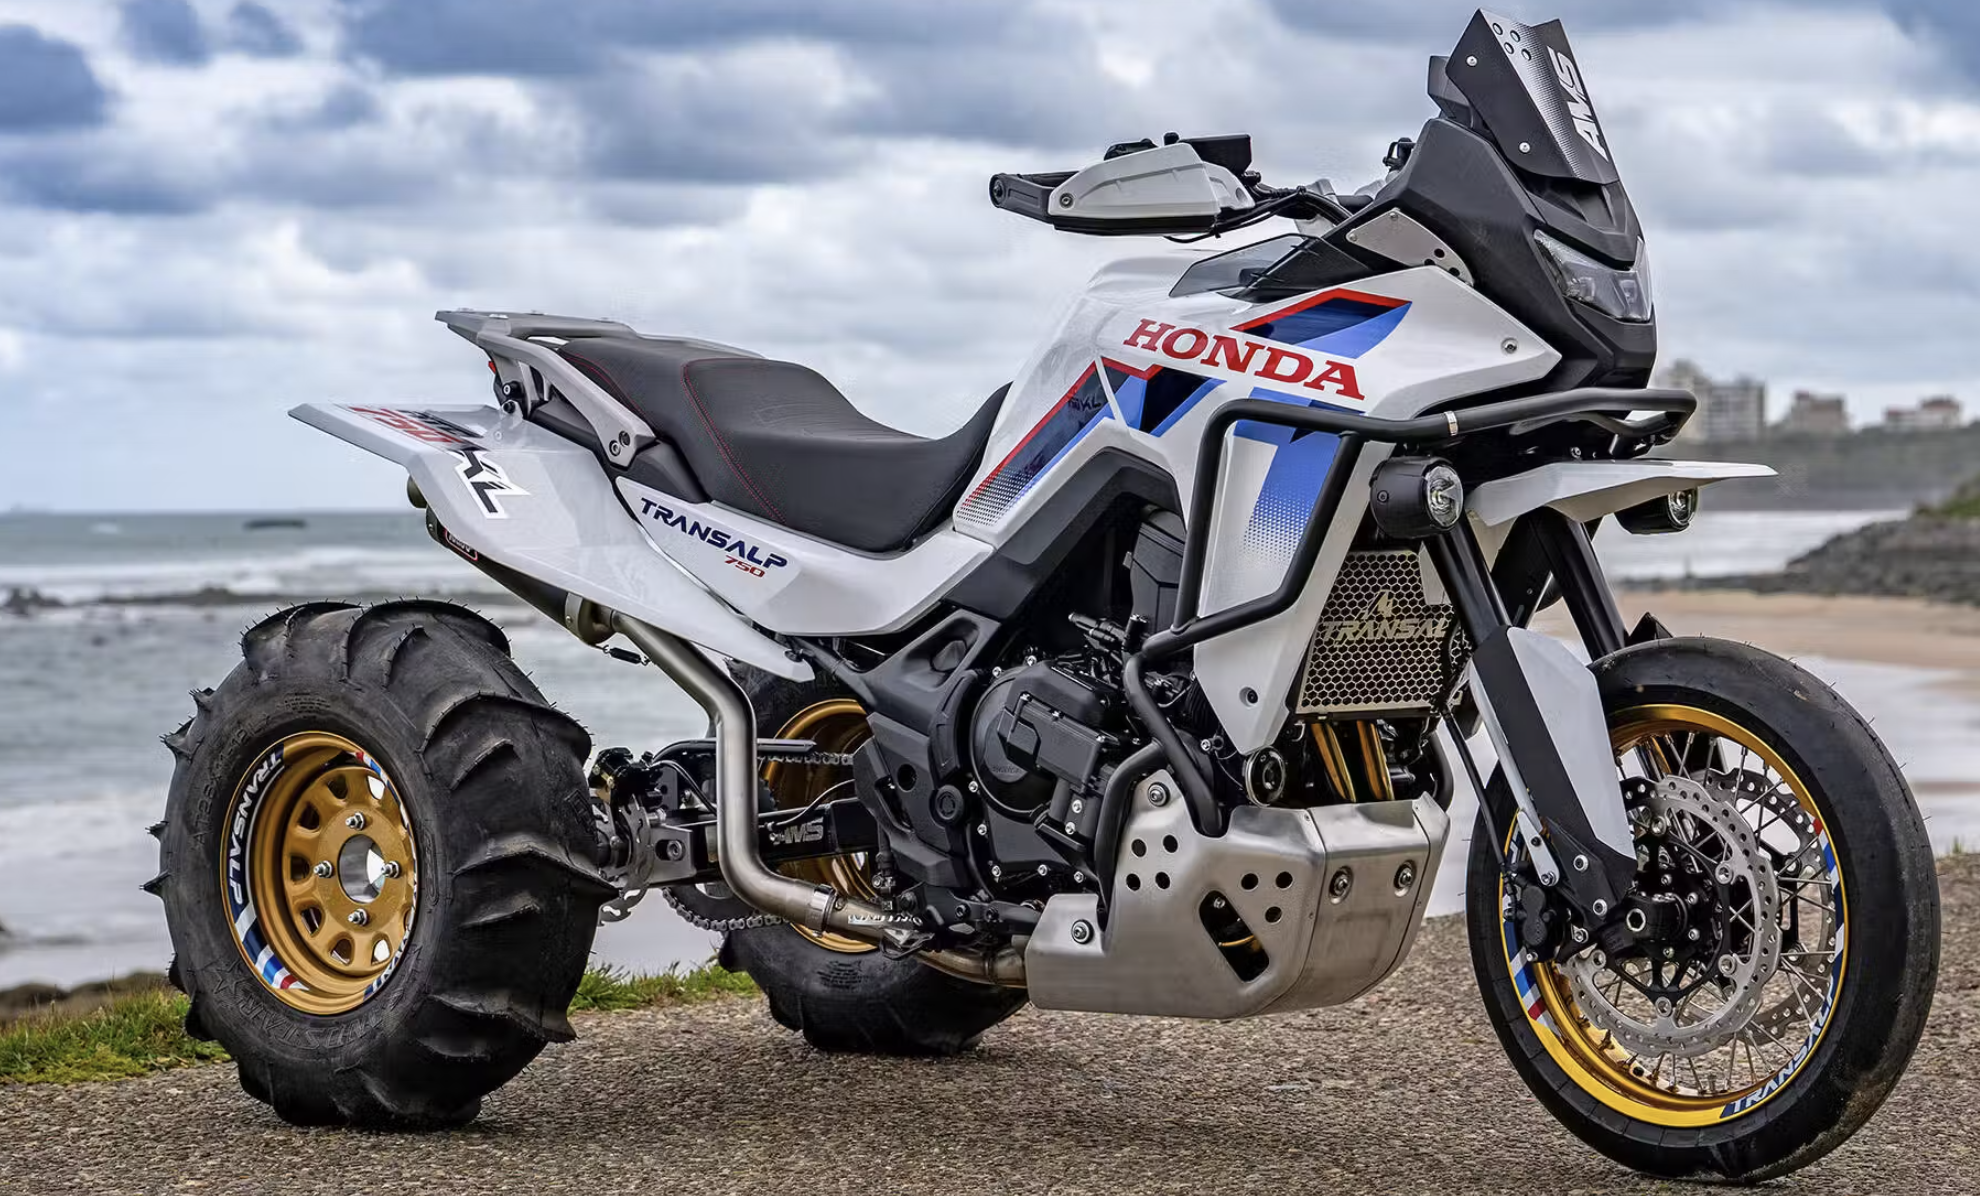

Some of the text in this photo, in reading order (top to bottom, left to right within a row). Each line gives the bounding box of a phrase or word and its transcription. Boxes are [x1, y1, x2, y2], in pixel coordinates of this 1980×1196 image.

[1546, 45, 1609, 162] AMS
[1123, 318, 1366, 400] HONDA
[640, 497, 788, 569] TRANSALP
[724, 554, 766, 579] 750
[1321, 617, 1448, 643] TRANSAL
[228, 752, 283, 905] TRANSALP
